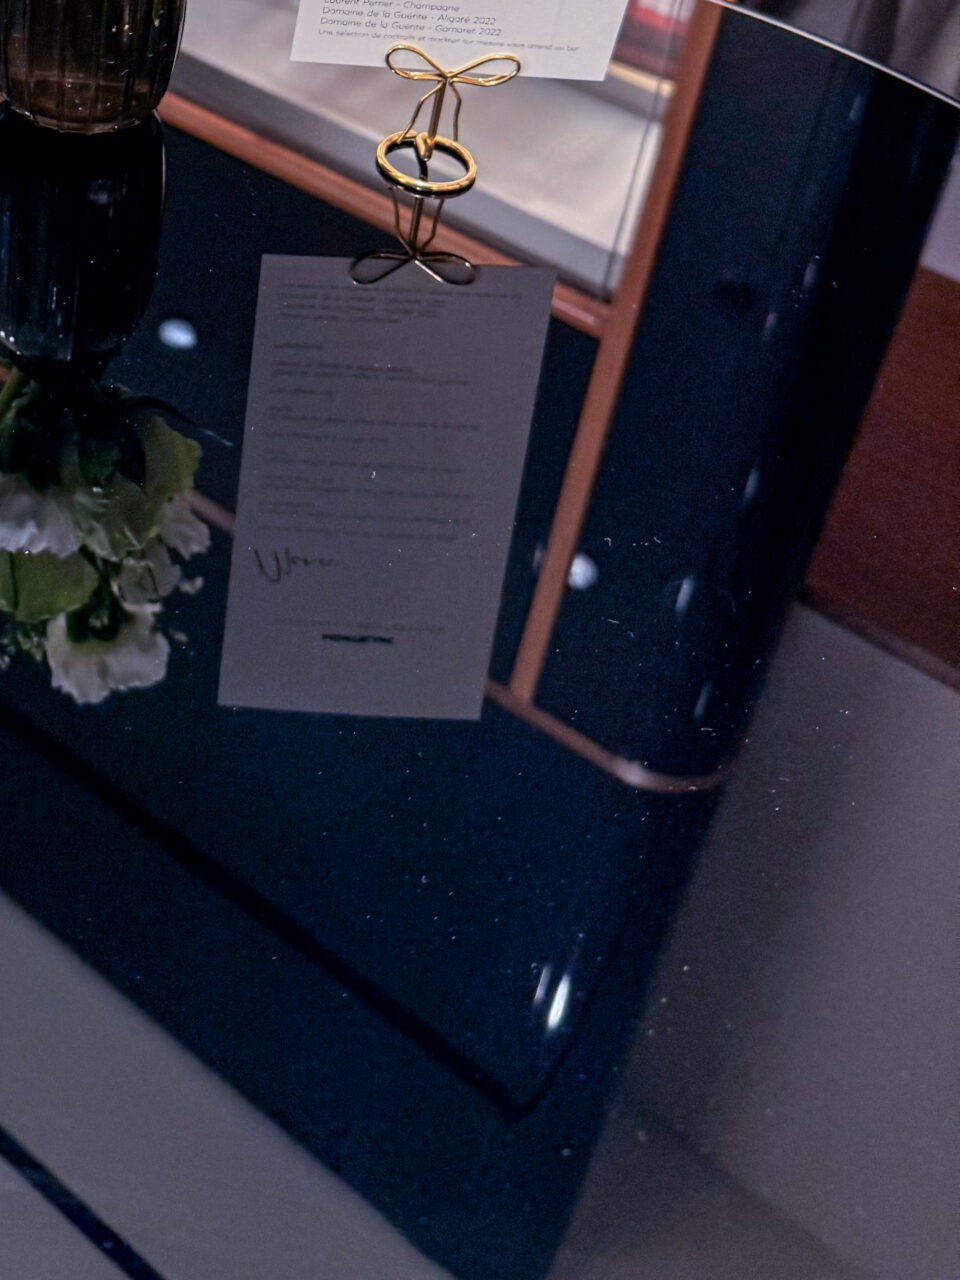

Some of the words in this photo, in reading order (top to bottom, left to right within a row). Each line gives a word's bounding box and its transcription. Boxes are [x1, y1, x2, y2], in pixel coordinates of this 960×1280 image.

[322, 6, 364, 16] Domaine
[366, 9, 379, 17] de
[382, 10, 391, 18] la
[472, 16, 496, 25] 2022
[403, 0, 460, 13] Champagne
[320, 16, 362, 27] Domaine
[364, 19, 377, 28] de
[380, 20, 388, 29] la
[434, 24, 476, 34] Gamaret
[478, 27, 502, 36] 2022
